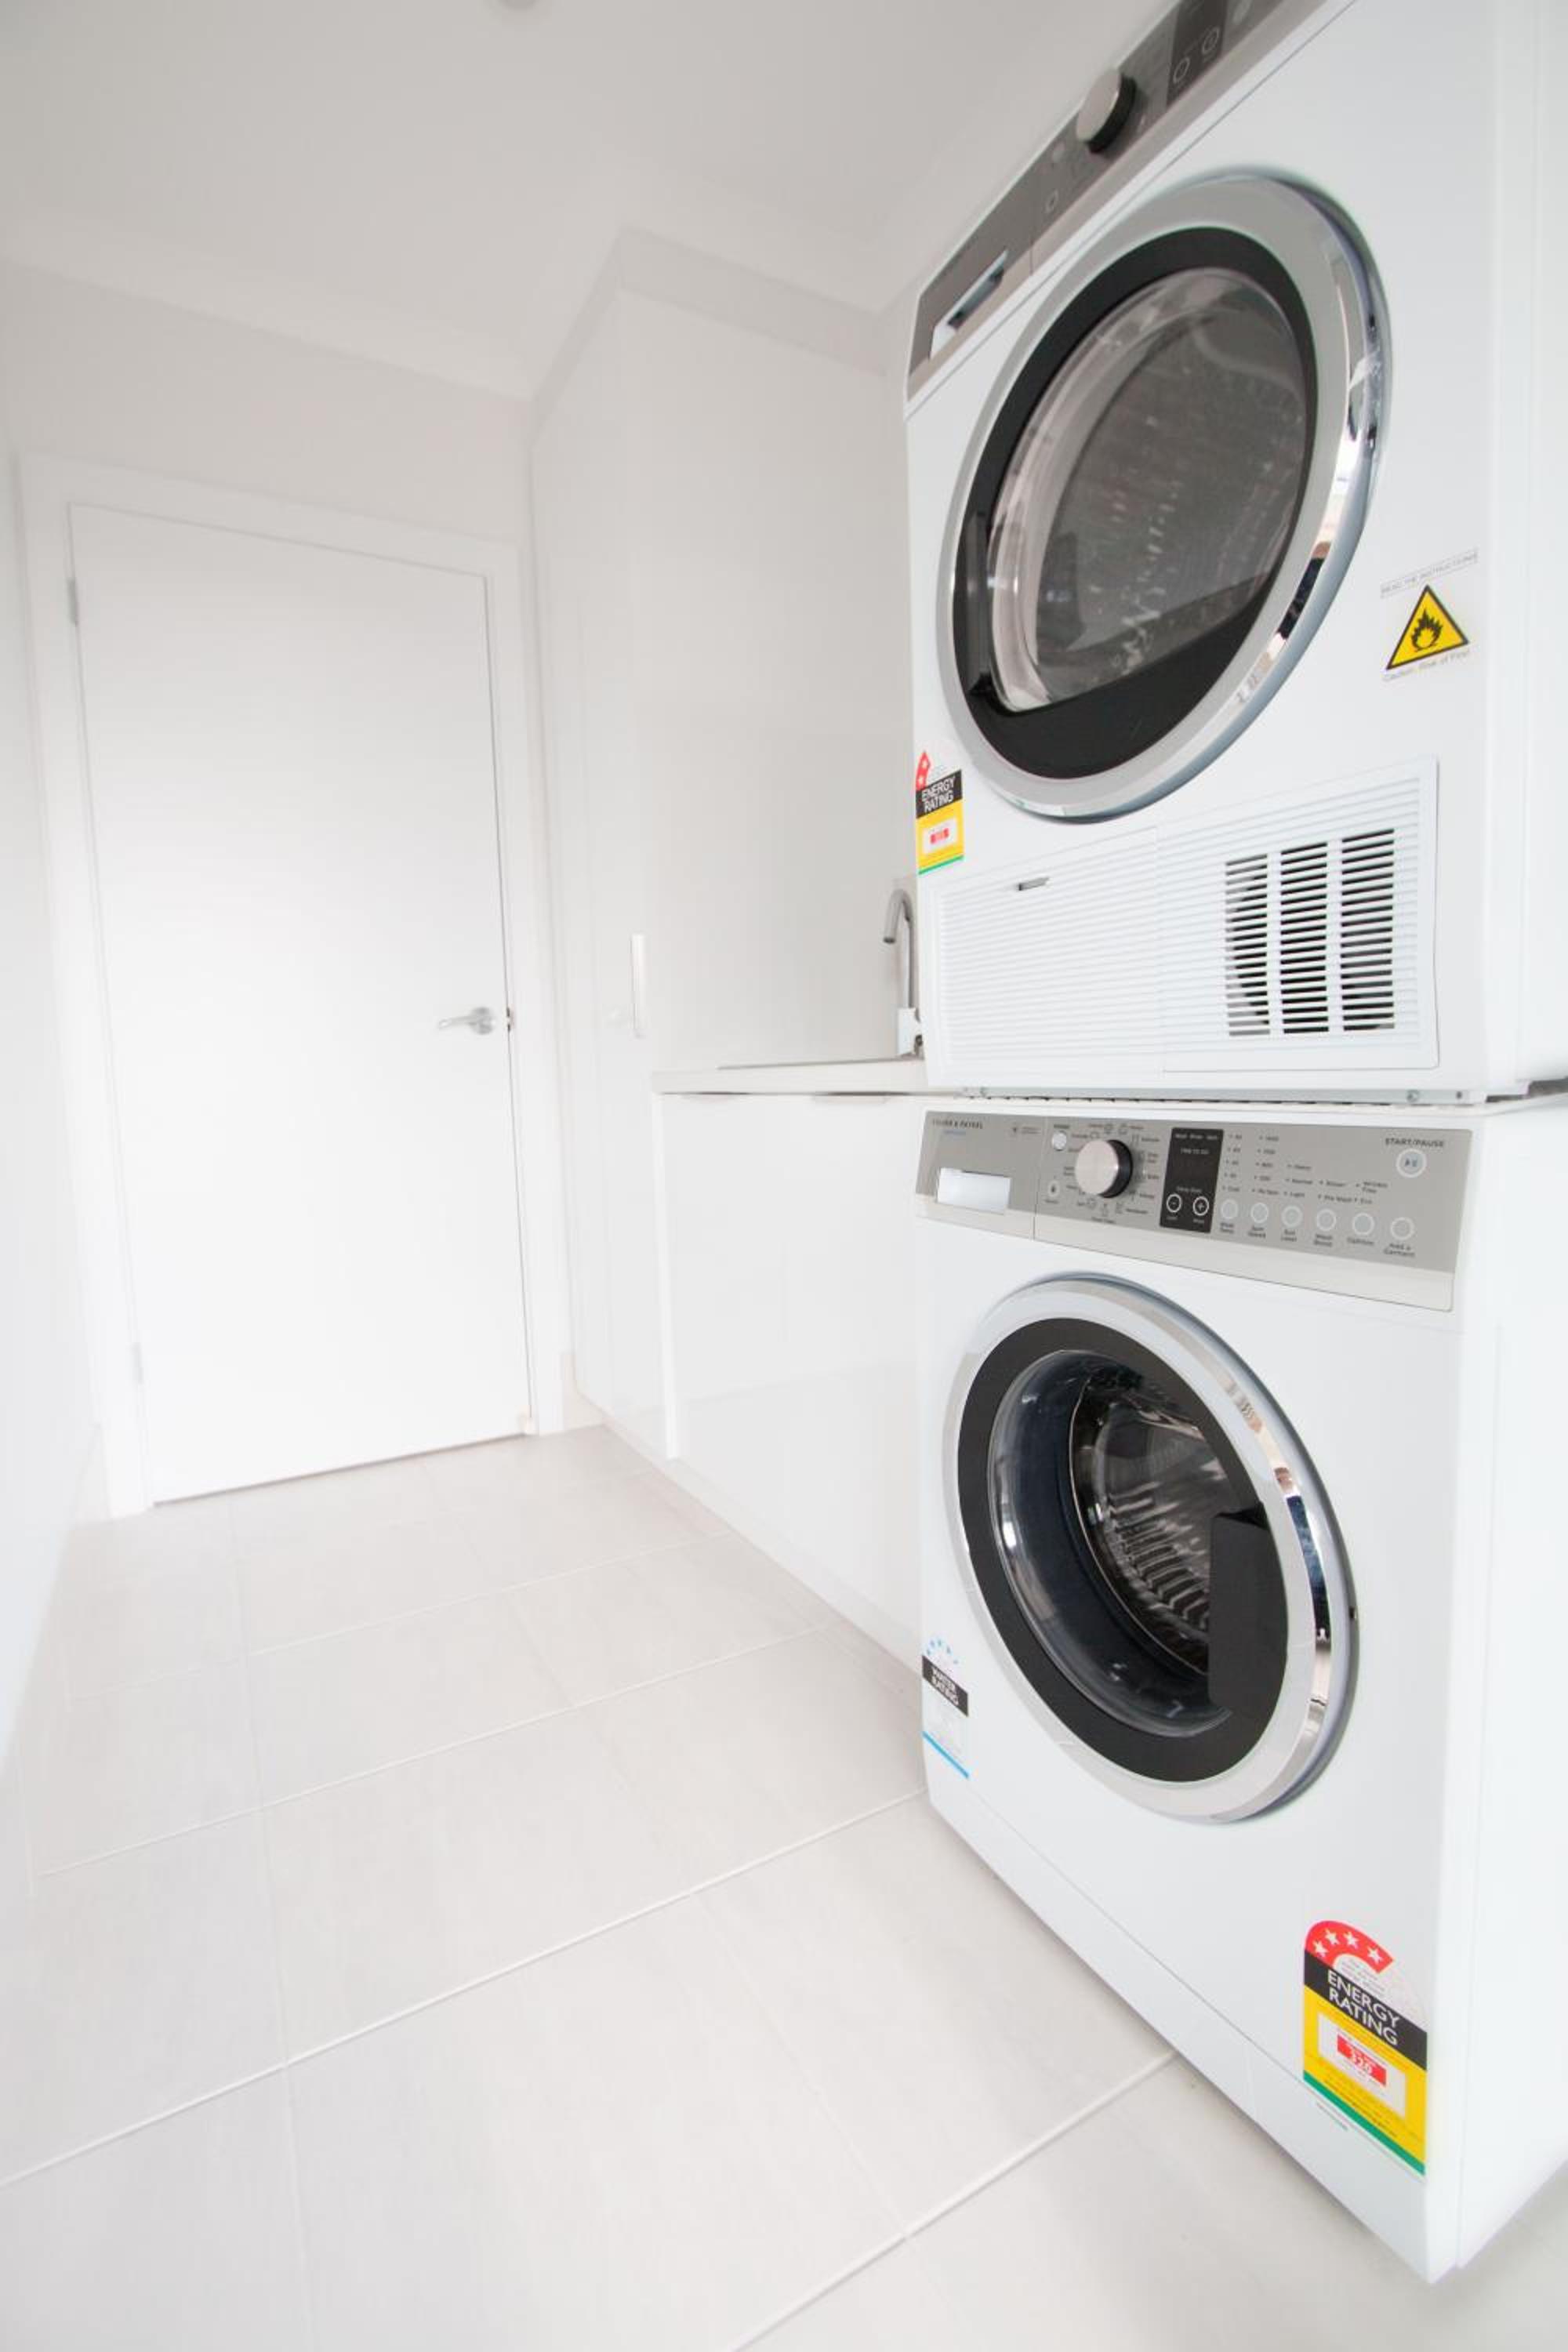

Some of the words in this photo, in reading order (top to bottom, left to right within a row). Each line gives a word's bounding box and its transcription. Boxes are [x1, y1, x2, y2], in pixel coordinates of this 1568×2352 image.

[921, 775, 956, 802] ENERGY
[924, 790, 954, 814] RATING
[1385, 1138, 1444, 1147] START/PAUSE
[931, 1667, 956, 1691] WATER
[931, 1676, 960, 1706] RATING
[1327, 1969, 1401, 2029] ENERGY
[1328, 1987, 1399, 2046] RATING
